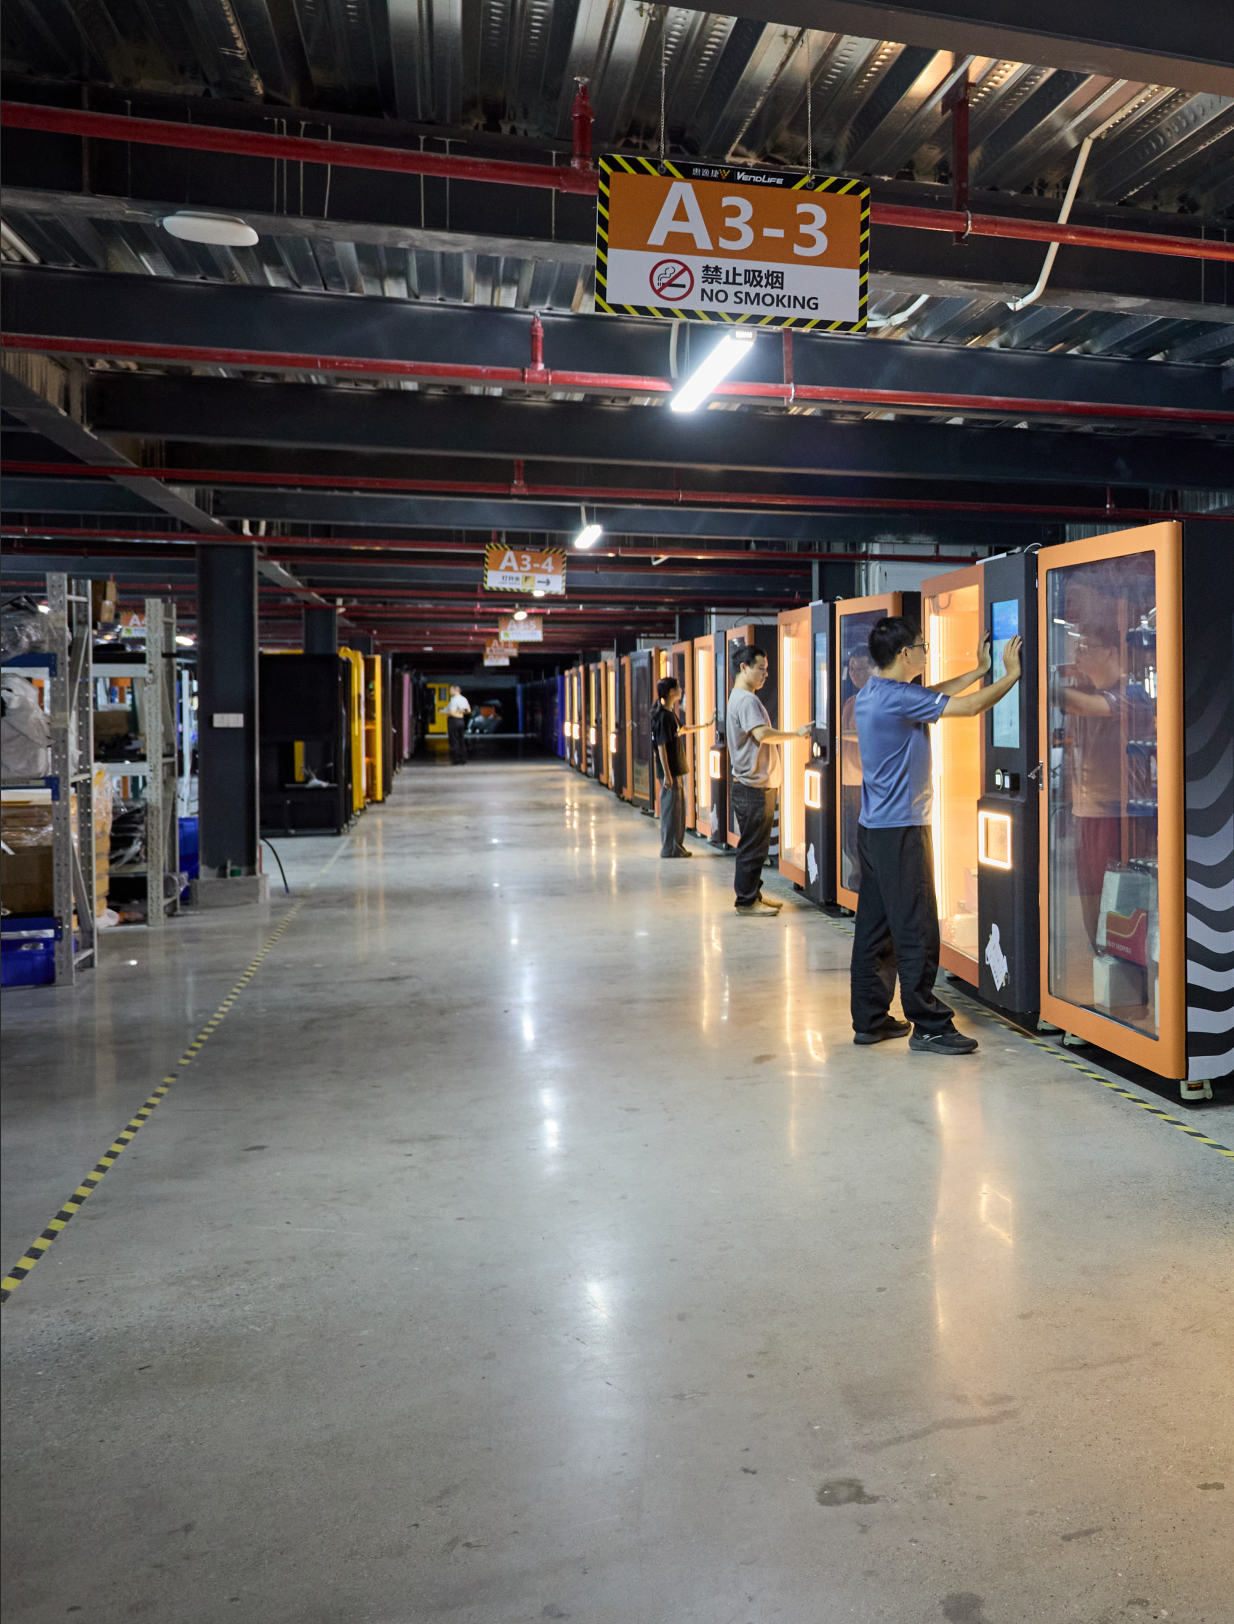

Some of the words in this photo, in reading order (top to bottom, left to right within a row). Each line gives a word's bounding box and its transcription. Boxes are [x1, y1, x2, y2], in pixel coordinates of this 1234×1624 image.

[646, 181, 828, 257] A3-3
[701, 264, 784, 290] 禁止吸烟
[700, 288, 729, 303] NO
[734, 291, 819, 311] SMOKING
[499, 551, 554, 573] A3-4
